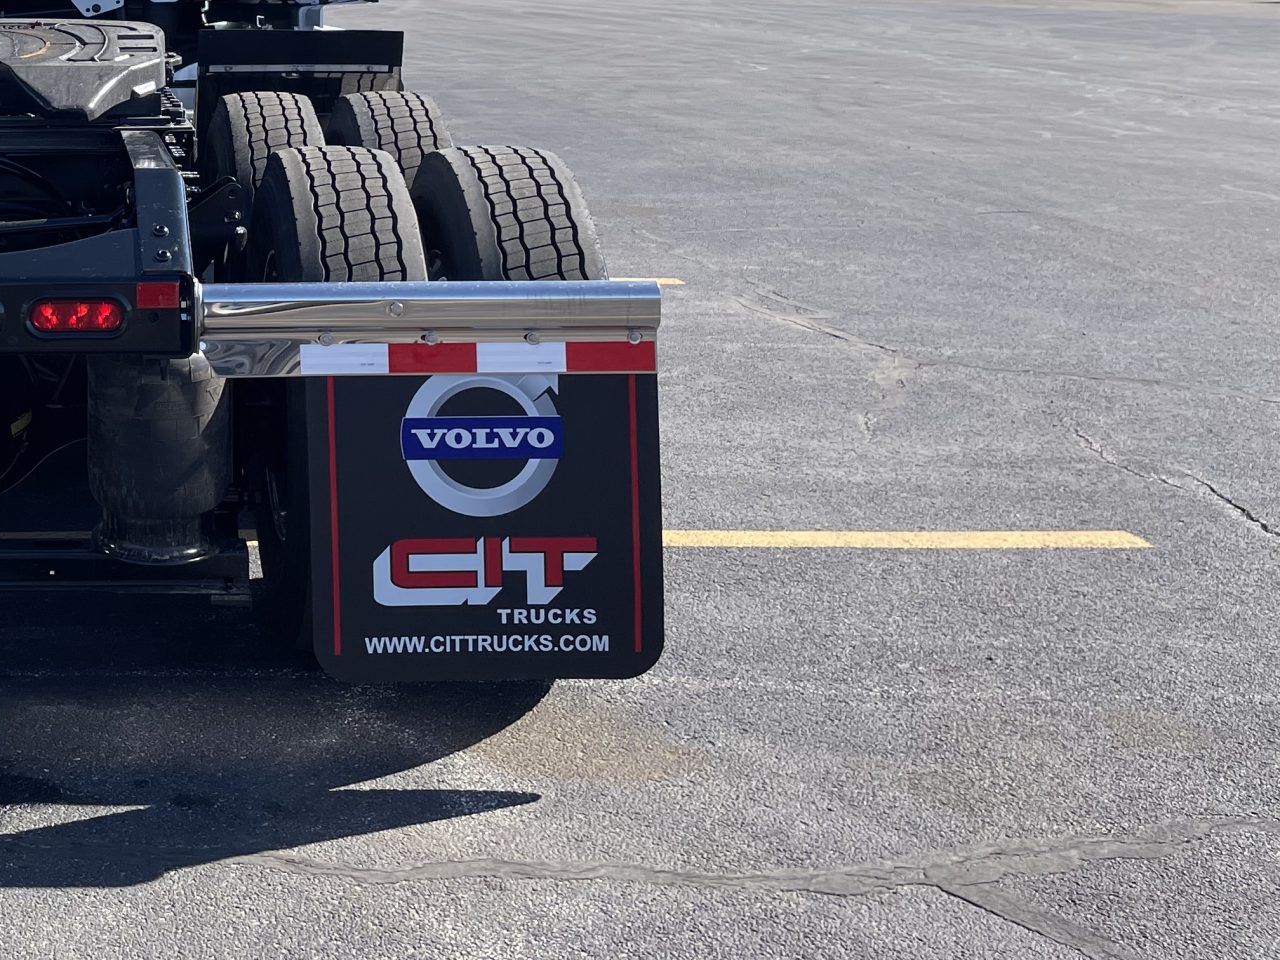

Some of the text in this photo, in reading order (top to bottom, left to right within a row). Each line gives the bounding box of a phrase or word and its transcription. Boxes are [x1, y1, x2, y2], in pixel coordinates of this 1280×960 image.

[410, 427, 555, 449] VOLVO
[373, 536, 599, 606] CIT
[496, 608, 598, 624] TRUCKS
[364, 634, 610, 655] WWW.CITTRUCKS.COM
